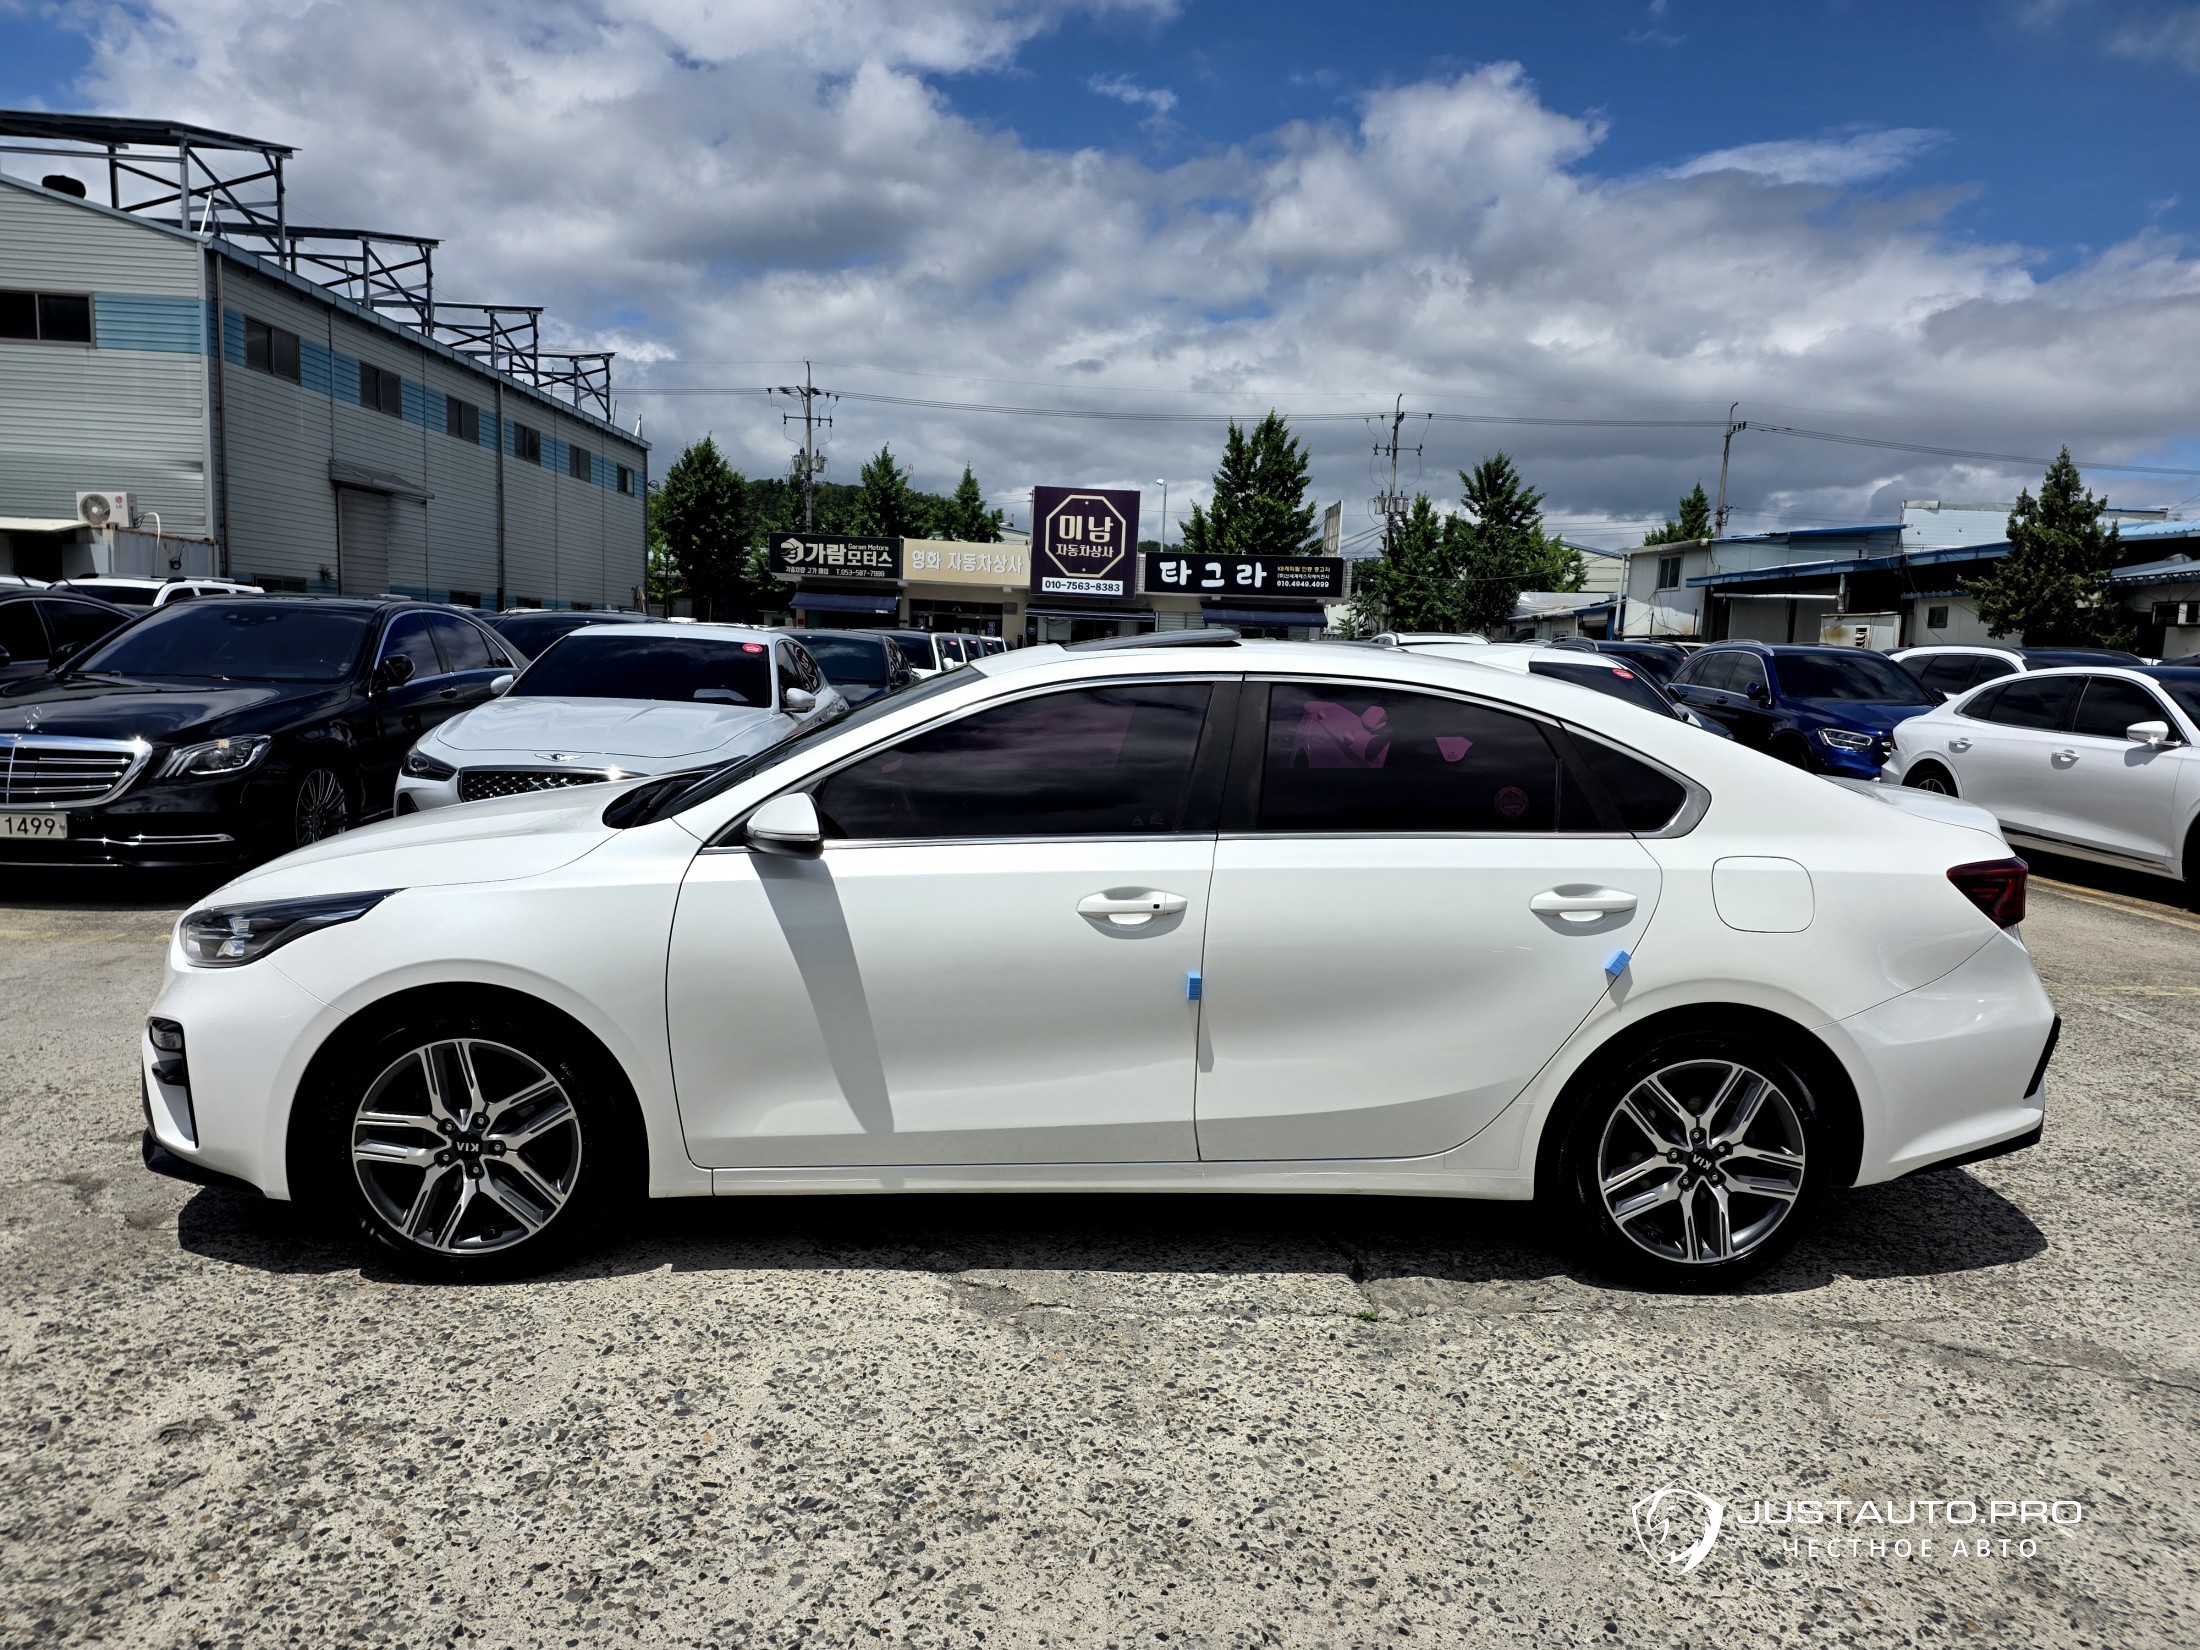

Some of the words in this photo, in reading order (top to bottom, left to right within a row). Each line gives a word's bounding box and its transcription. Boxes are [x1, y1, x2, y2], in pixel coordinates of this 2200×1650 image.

[1059, 515, 1114, 543] 미남
[1055, 543, 1114, 558] 자동차상사
[911, 550, 942, 570] 영화
[948, 552, 1023, 574] 자동차상사
[1159, 559, 1268, 588] 타그라
[1044, 580, 1121, 592] 010-7563-8383
[4, 816, 56, 836] 1499
[456, 1141, 480, 1152] KIA
[1692, 1153, 1712, 1170] KIA
